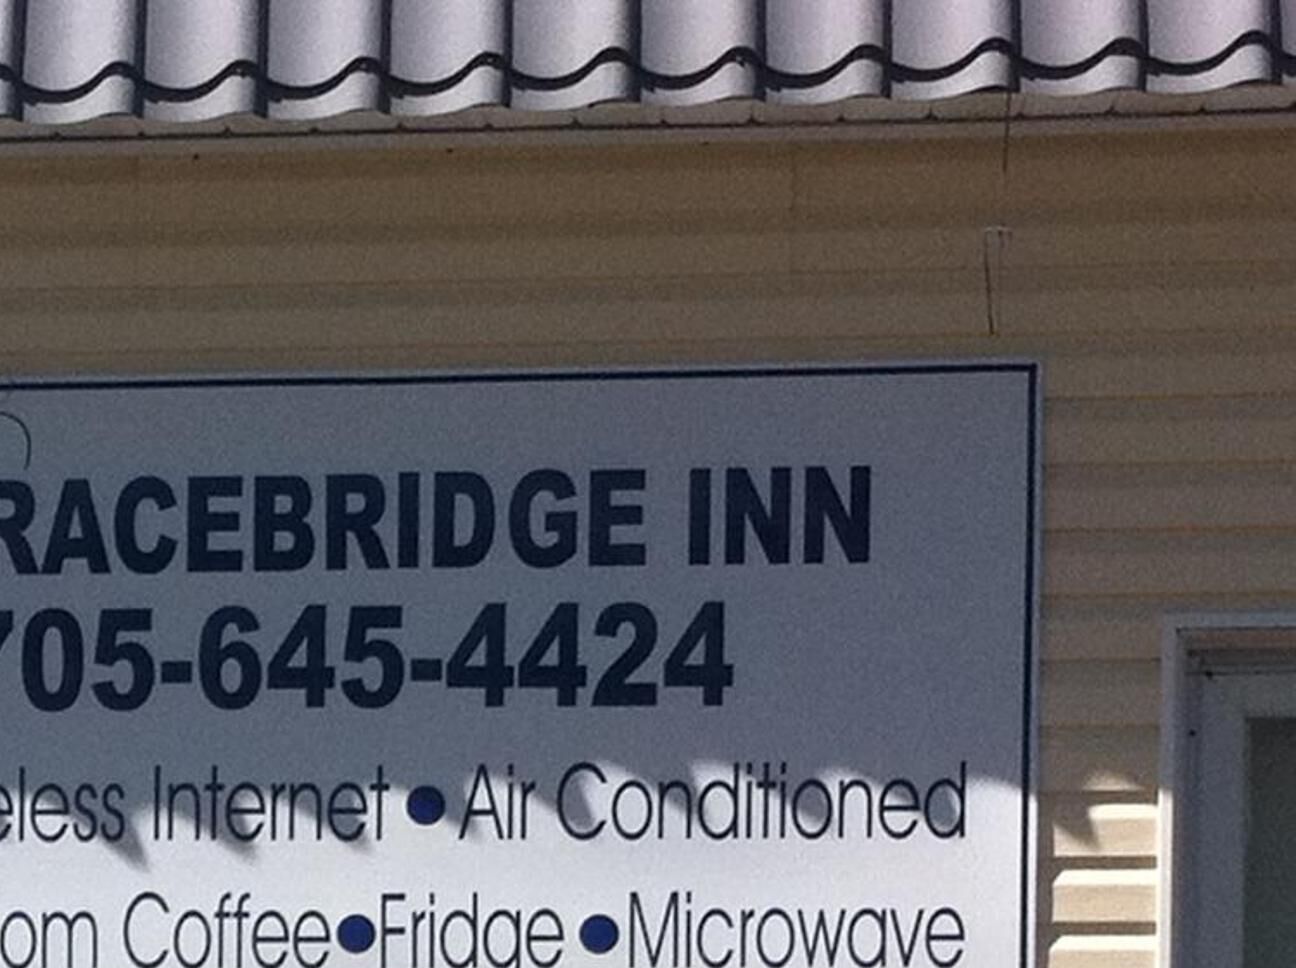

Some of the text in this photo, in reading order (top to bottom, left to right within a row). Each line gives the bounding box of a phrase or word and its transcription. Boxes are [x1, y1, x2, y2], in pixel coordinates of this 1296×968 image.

[688, 464, 872, 566] INN
[152, 763, 391, 843] Internet
[458, 762, 536, 841] Air
[556, 760, 968, 841] Conditioned
